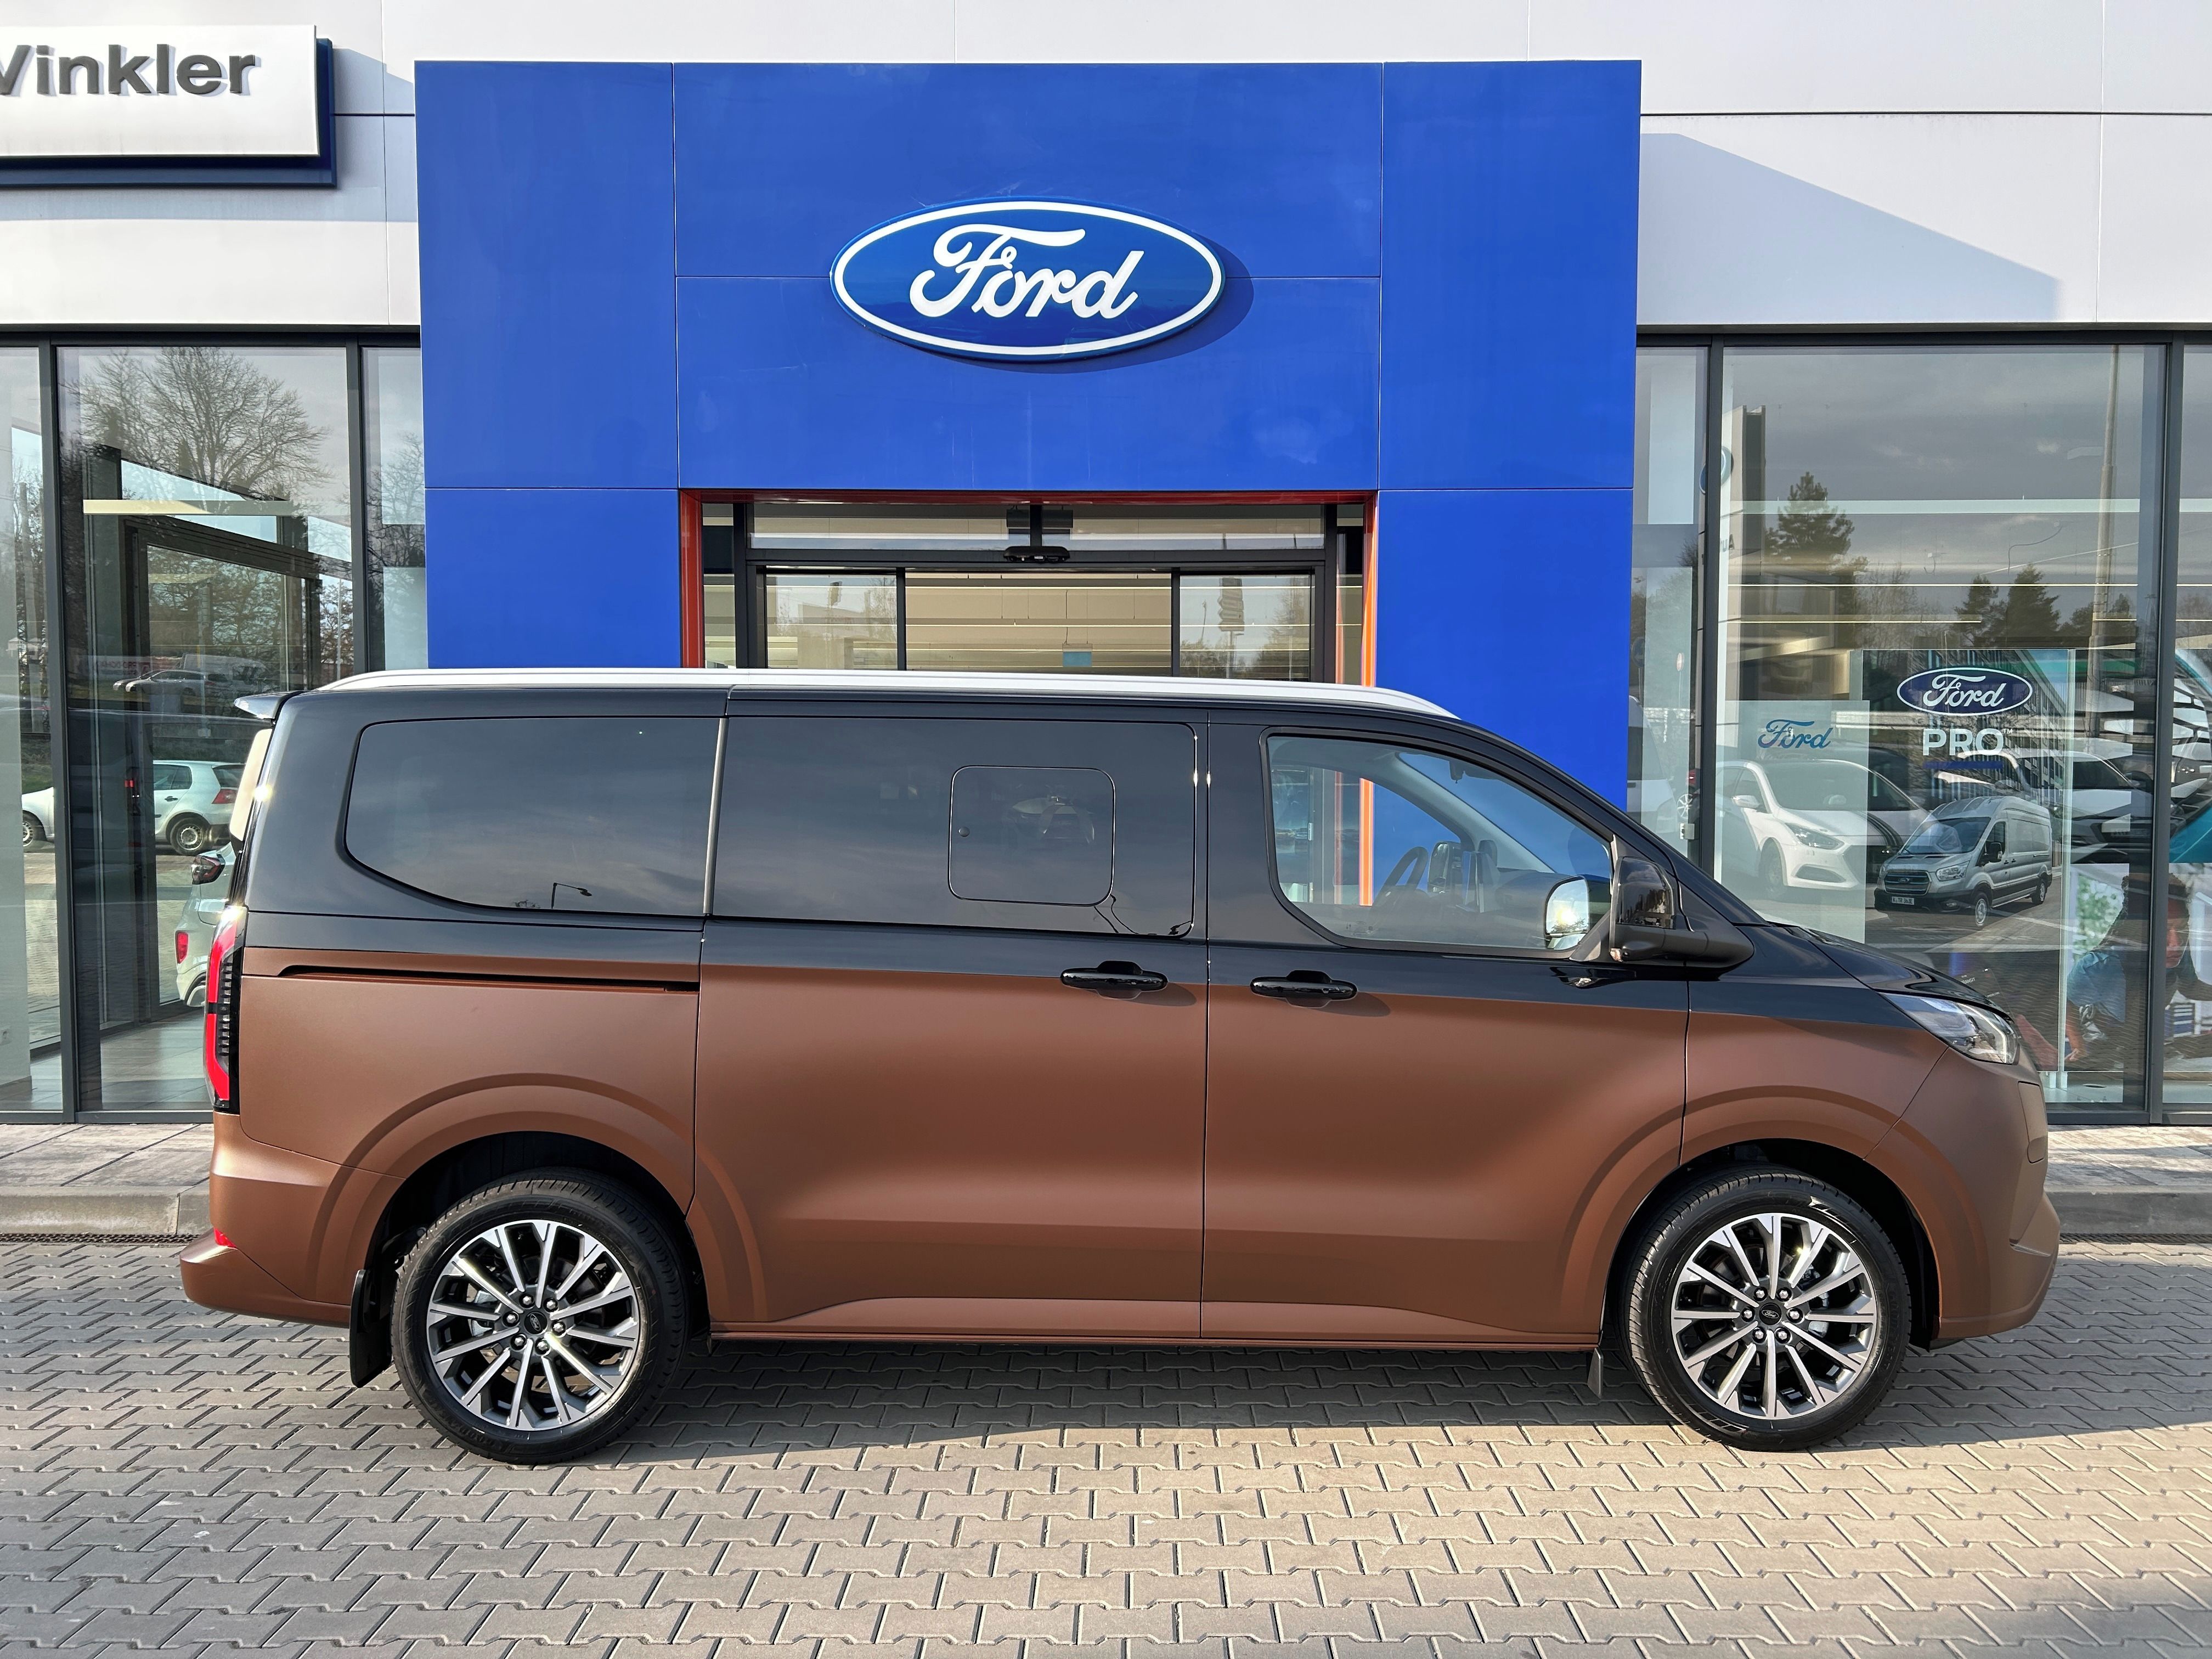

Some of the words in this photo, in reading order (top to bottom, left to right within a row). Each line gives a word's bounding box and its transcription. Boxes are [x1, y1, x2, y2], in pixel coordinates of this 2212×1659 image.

[910, 224, 1144, 318] Ford
[1923, 674, 2007, 707] Ford
[1758, 719, 1833, 748] Ford
[1923, 728, 2004, 755] PRO
